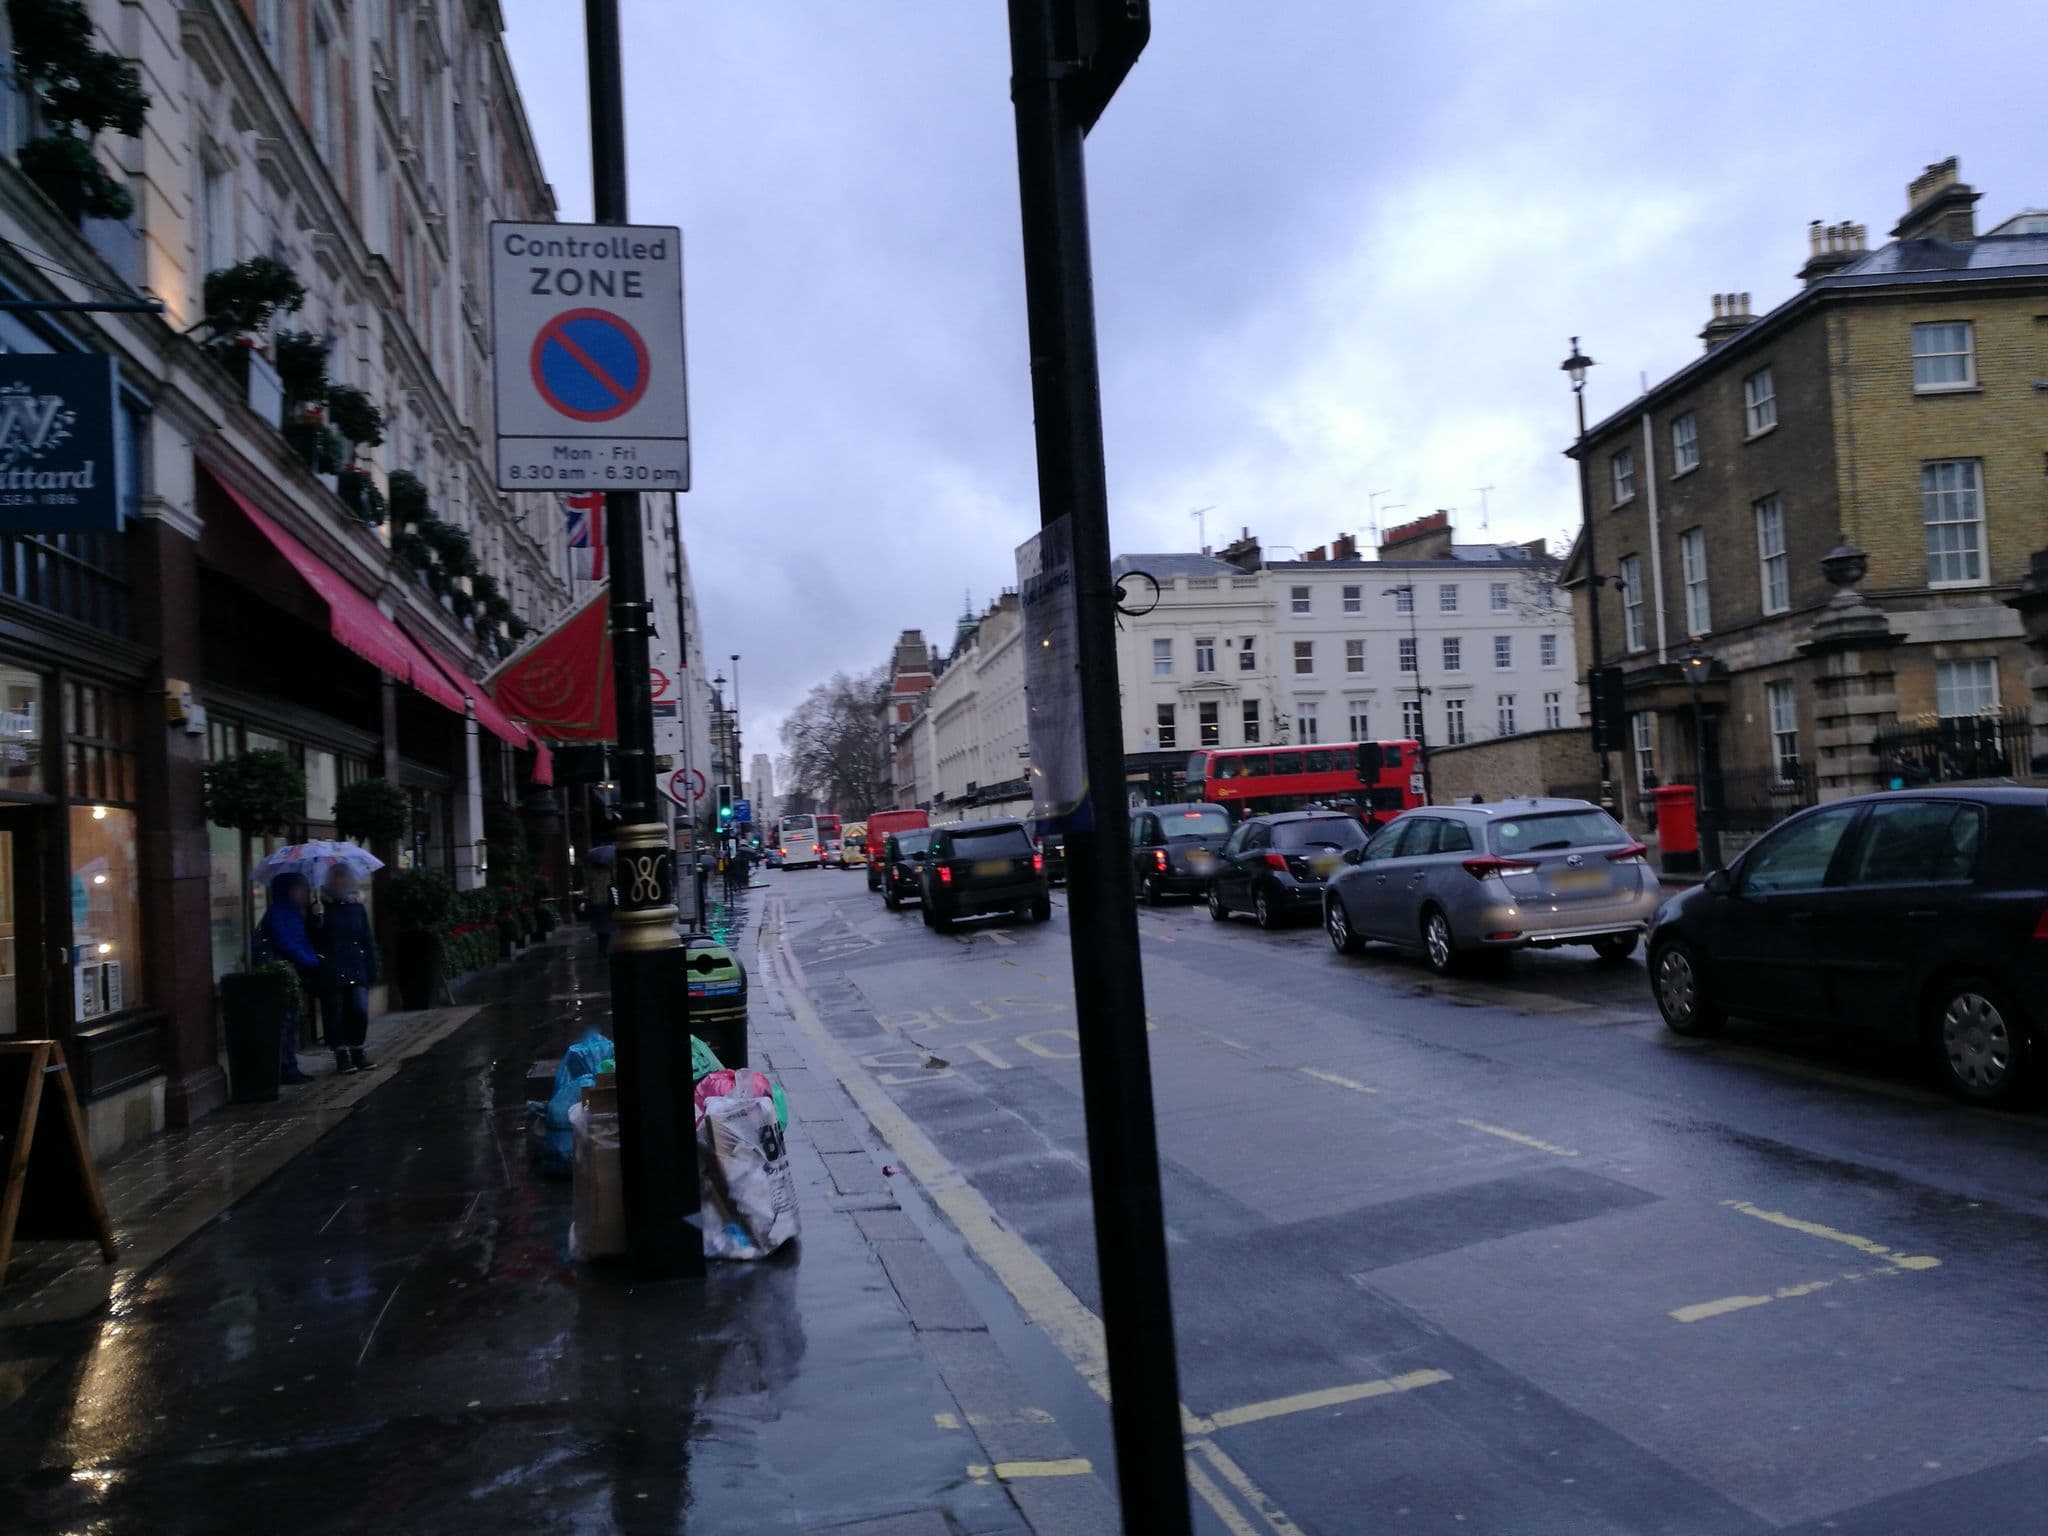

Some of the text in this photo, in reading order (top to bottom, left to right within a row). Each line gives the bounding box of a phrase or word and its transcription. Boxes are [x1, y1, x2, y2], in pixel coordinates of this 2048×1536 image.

[504, 233, 667, 261] Controlled
[530, 267, 644, 299] ZONE
[552, 445, 593, 461] Mon
[612, 446, 637, 460] Fri
[509, 464, 555, 480] 8.30
[558, 468, 586, 480] am
[604, 464, 649, 481] 6.30
[652, 468, 682, 485] pm
